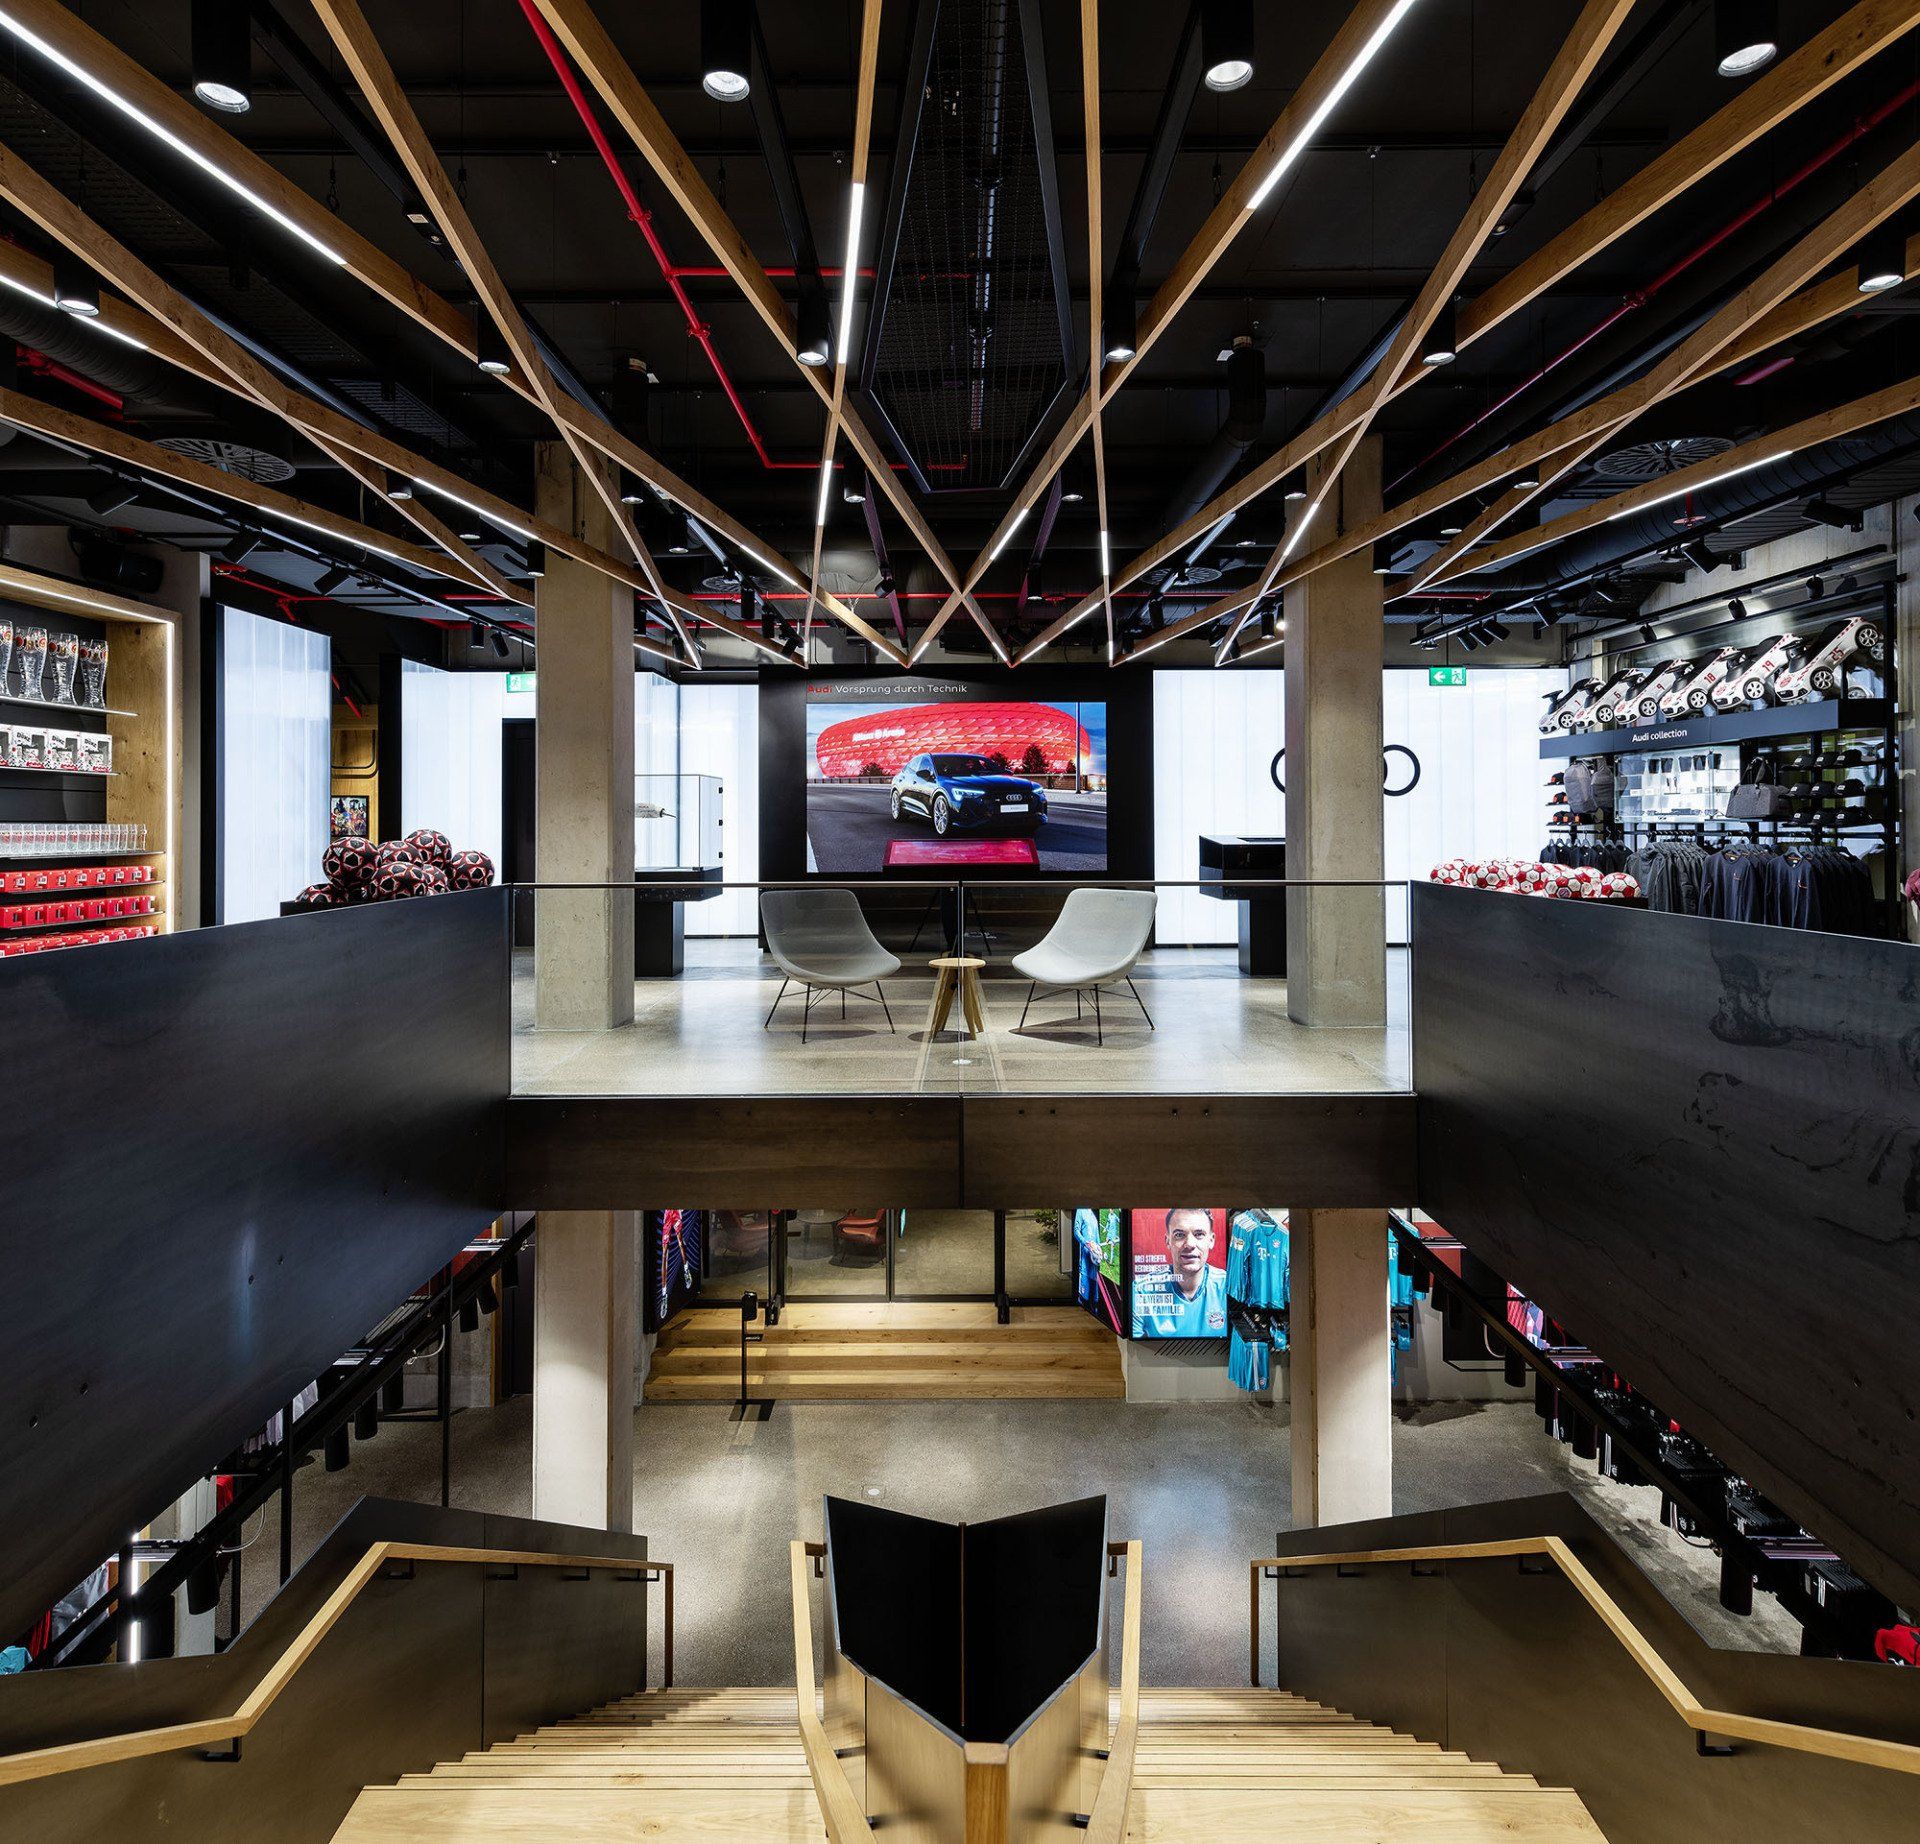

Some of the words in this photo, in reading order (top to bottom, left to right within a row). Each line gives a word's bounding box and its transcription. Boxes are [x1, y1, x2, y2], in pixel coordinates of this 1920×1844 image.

[1830, 647, 1845, 661] 25
[1762, 660, 1775, 672] 19
[1703, 672, 1716, 684] 18
[807, 685, 833, 693] Audi
[835, 685, 891, 695] Vorsprung
[894, 685, 925, 693] durch
[927, 685, 967, 693] Technik
[1656, 683, 1665, 691] 9
[1613, 691, 1622, 699] 6
[1631, 732, 1649, 743] Audi
[1650, 728, 1688, 741] collection
